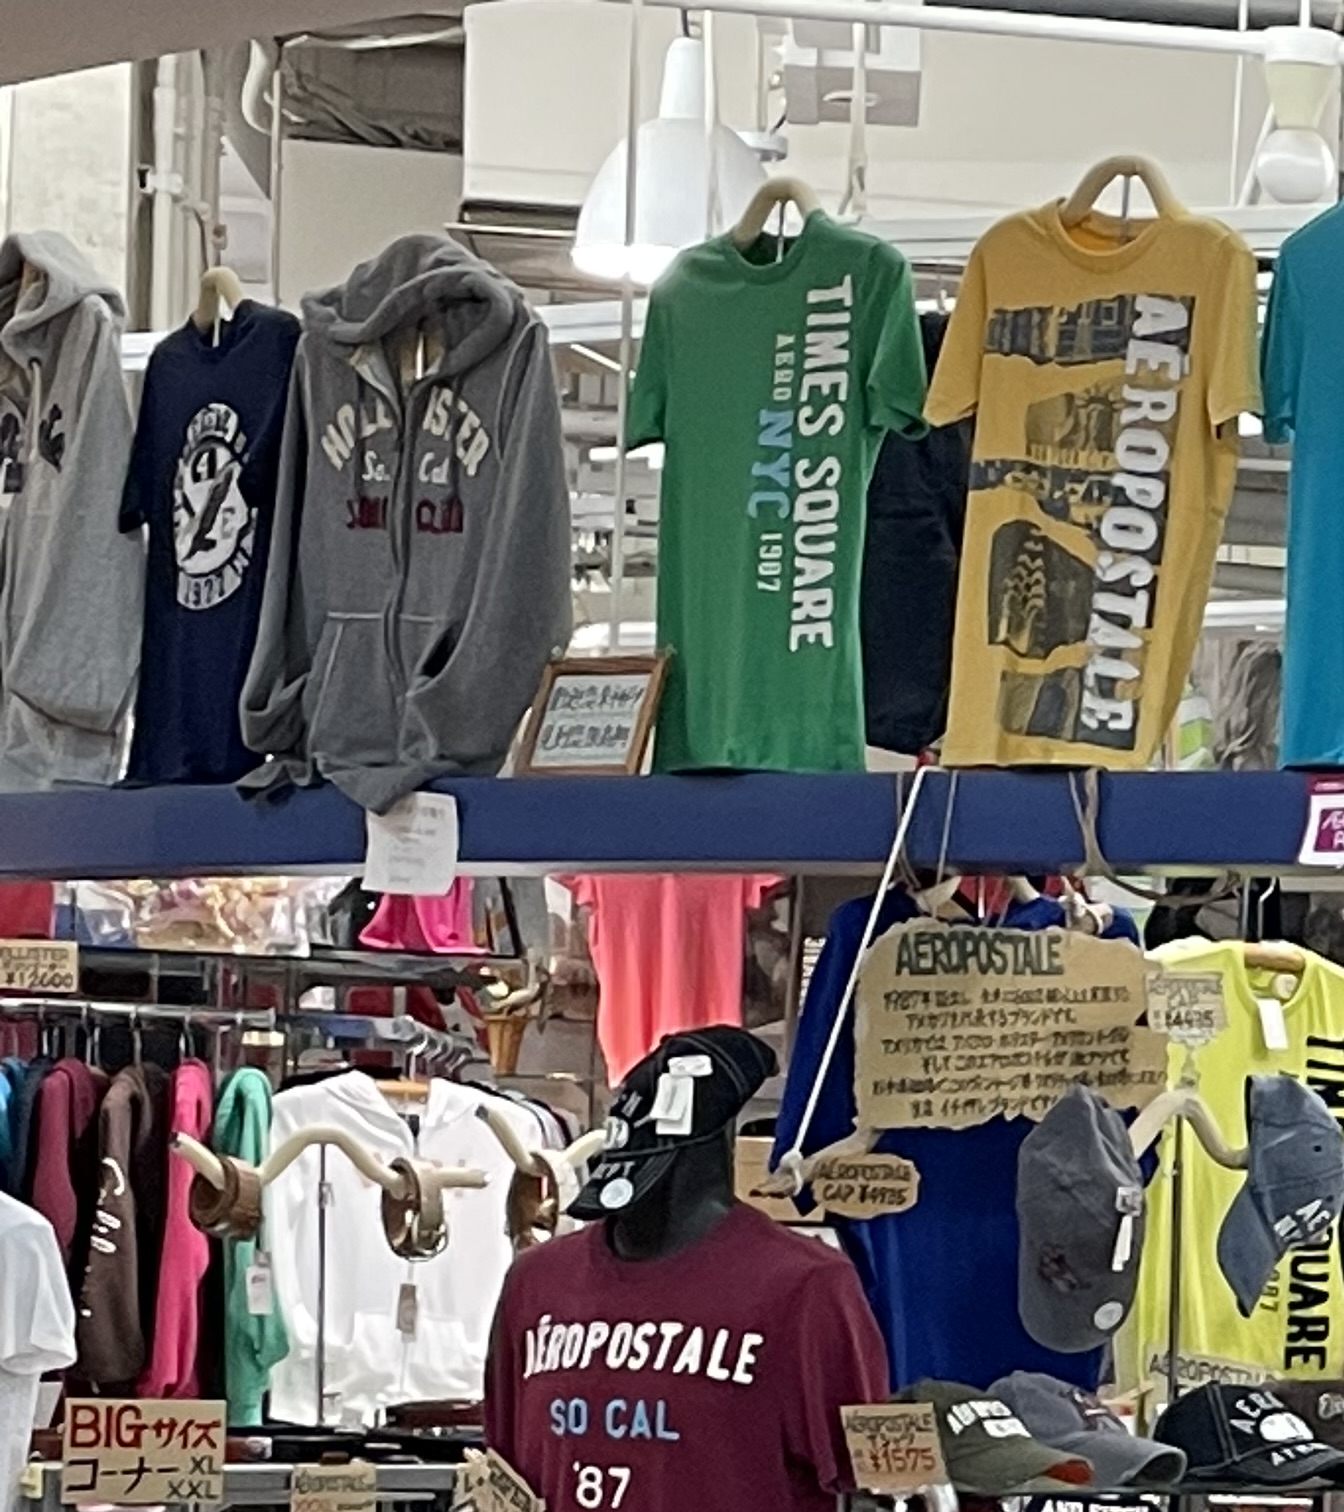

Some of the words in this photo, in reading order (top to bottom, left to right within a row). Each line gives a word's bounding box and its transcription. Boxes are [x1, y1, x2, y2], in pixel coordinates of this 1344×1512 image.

[773, 334, 795, 400] AERO
[797, 274, 853, 437] TIMES
[747, 409, 795, 519] NYC
[788, 457, 841, 652] SQUARE
[1284, 1228, 1334, 1371] UARE
[549, 1398, 588, 1437] SO
[605, 1399, 680, 1442] CAL
[66, 1456, 181, 1496] コーナー
[189, 1455, 221, 1476] XL
[572, 1461, 632, 1509] '87
[870, 1448, 936, 1473] ¥1575
[166, 1479, 219, 1500] XXL
